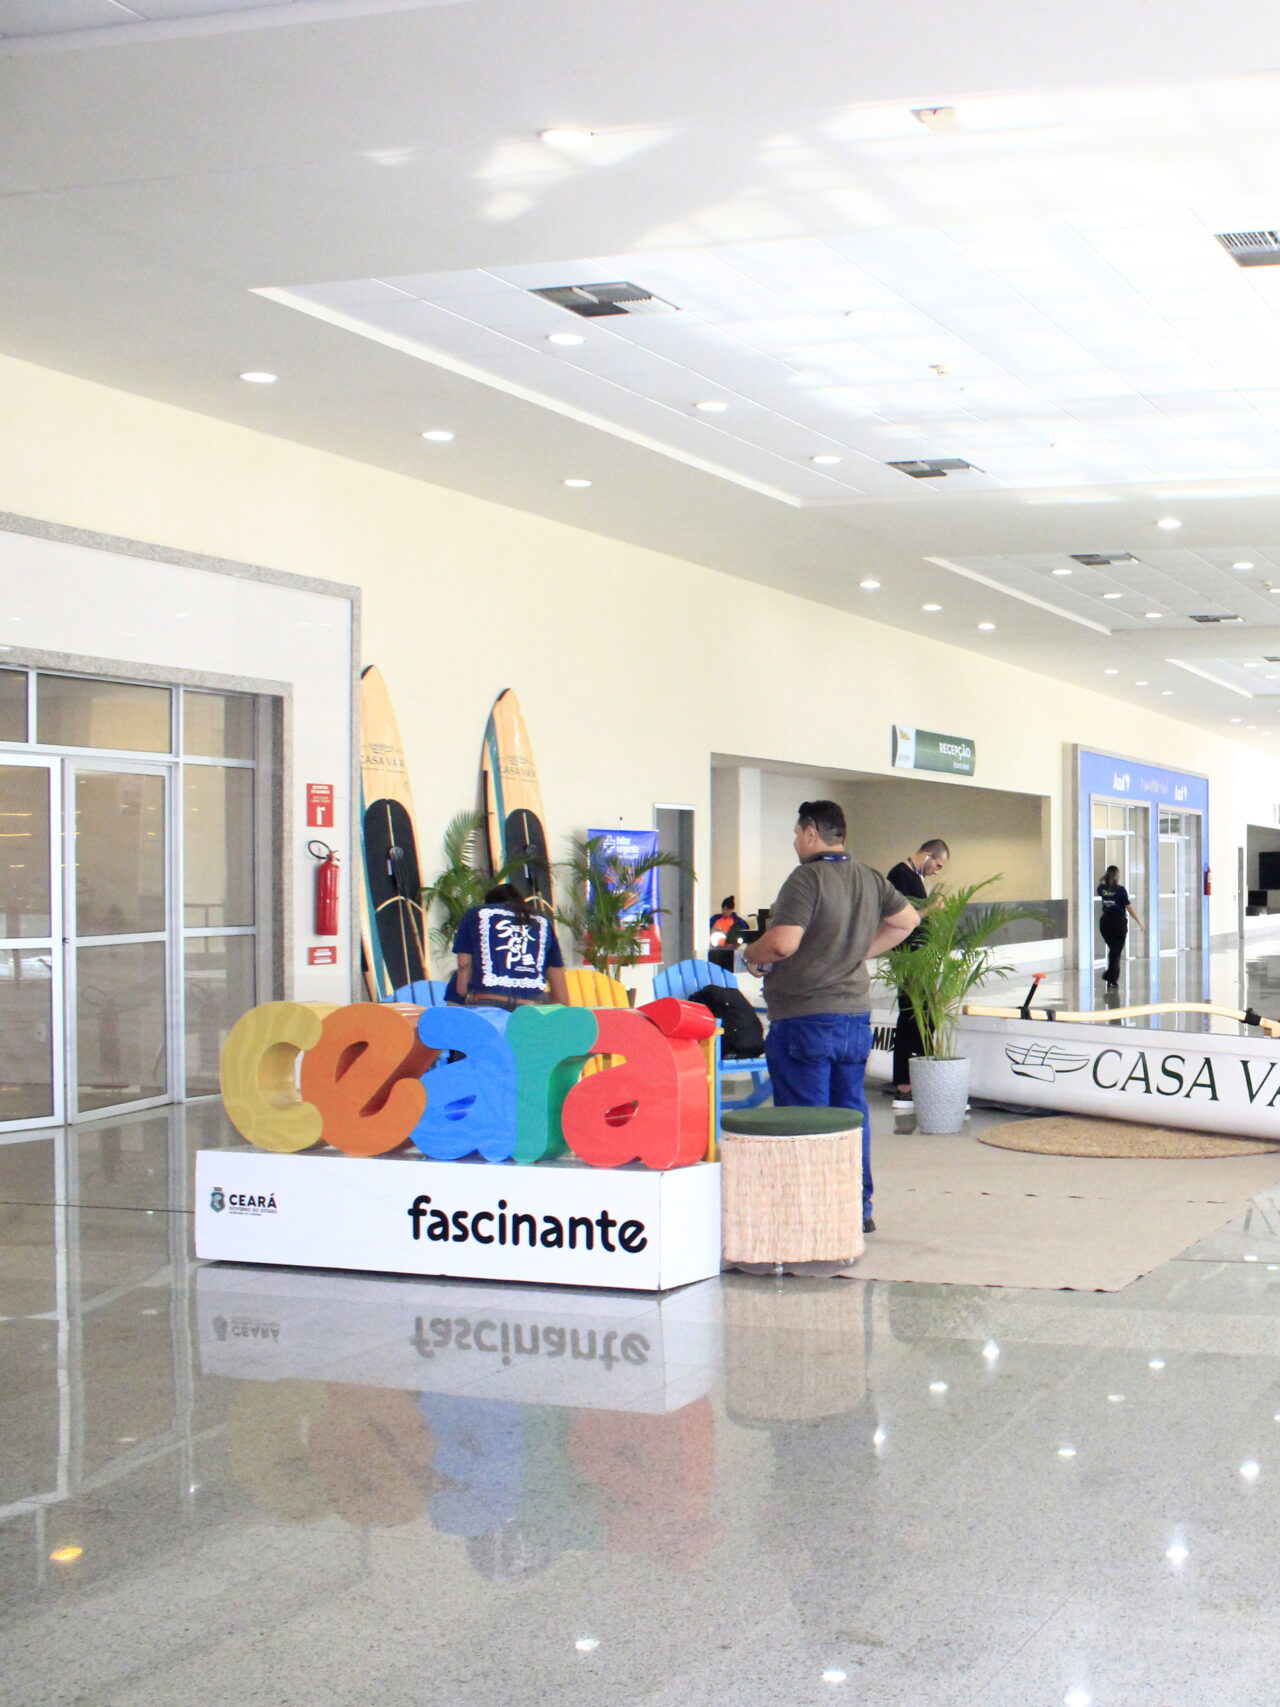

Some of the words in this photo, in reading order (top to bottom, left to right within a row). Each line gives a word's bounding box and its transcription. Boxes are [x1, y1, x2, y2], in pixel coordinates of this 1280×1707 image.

[938, 742, 971, 760] RECEPÇÃO
[220, 996, 716, 1170] ceará
[1092, 1048, 1220, 1102] CASA
[229, 1192, 277, 1208] CEARÁ
[407, 1194, 648, 1254] fascinante
